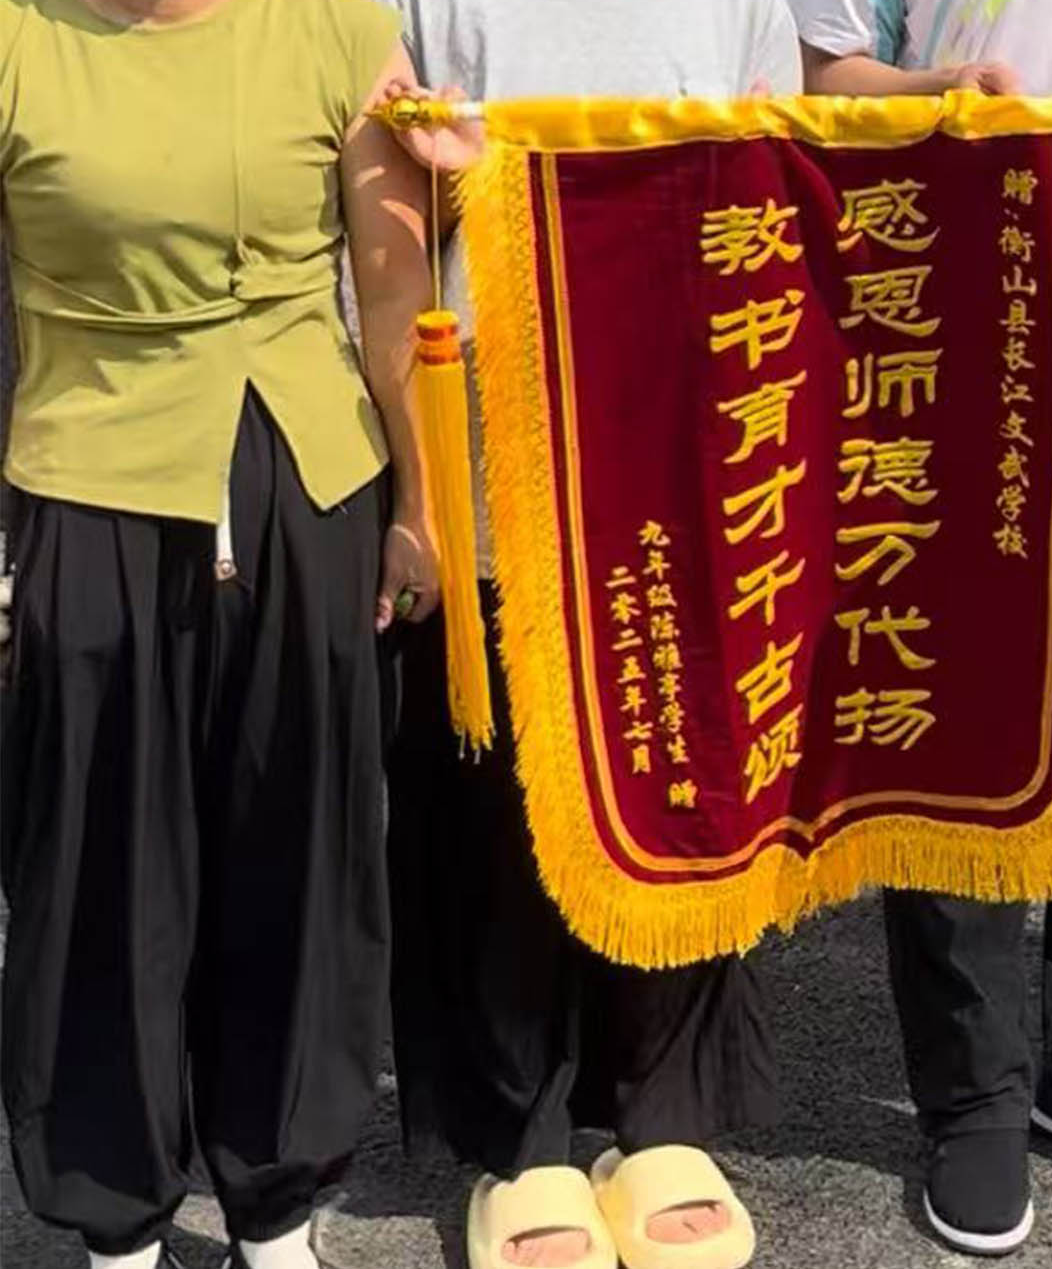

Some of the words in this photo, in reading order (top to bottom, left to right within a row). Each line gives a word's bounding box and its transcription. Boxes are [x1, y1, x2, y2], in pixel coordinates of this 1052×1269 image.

[699, 198, 808, 806] 教书育才千古颂
[833, 178, 942, 751] 感恩师德万代扬
